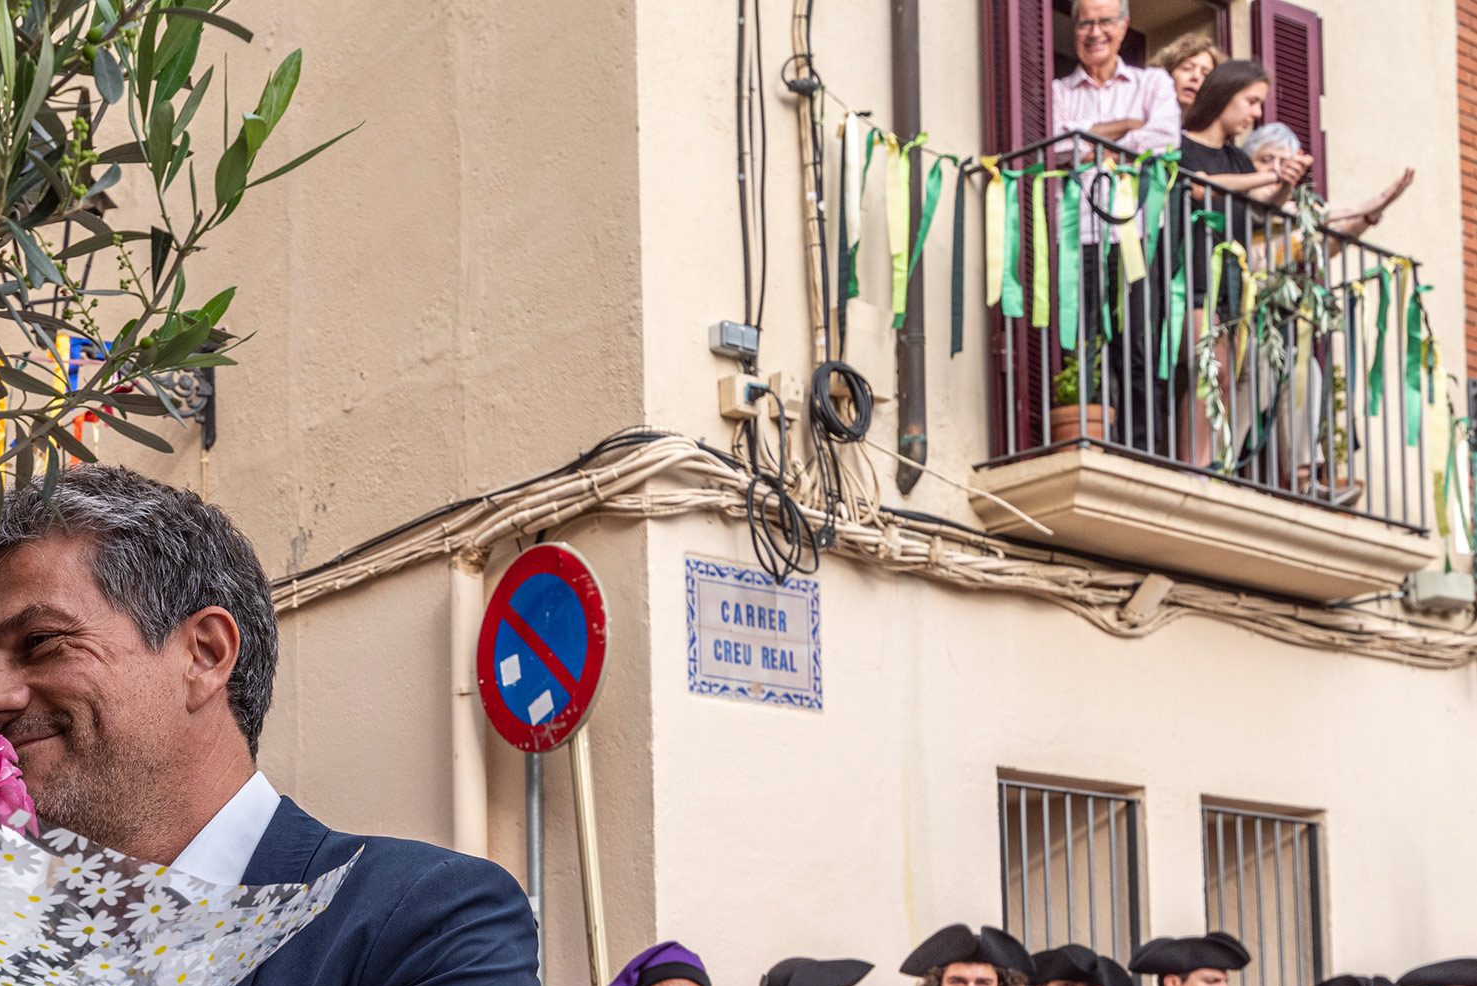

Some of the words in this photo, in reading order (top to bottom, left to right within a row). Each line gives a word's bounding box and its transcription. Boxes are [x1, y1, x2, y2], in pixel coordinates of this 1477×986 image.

[721, 600, 787, 633] CARRER
[713, 639, 752, 666] CREU
[761, 646, 798, 673] REAL
